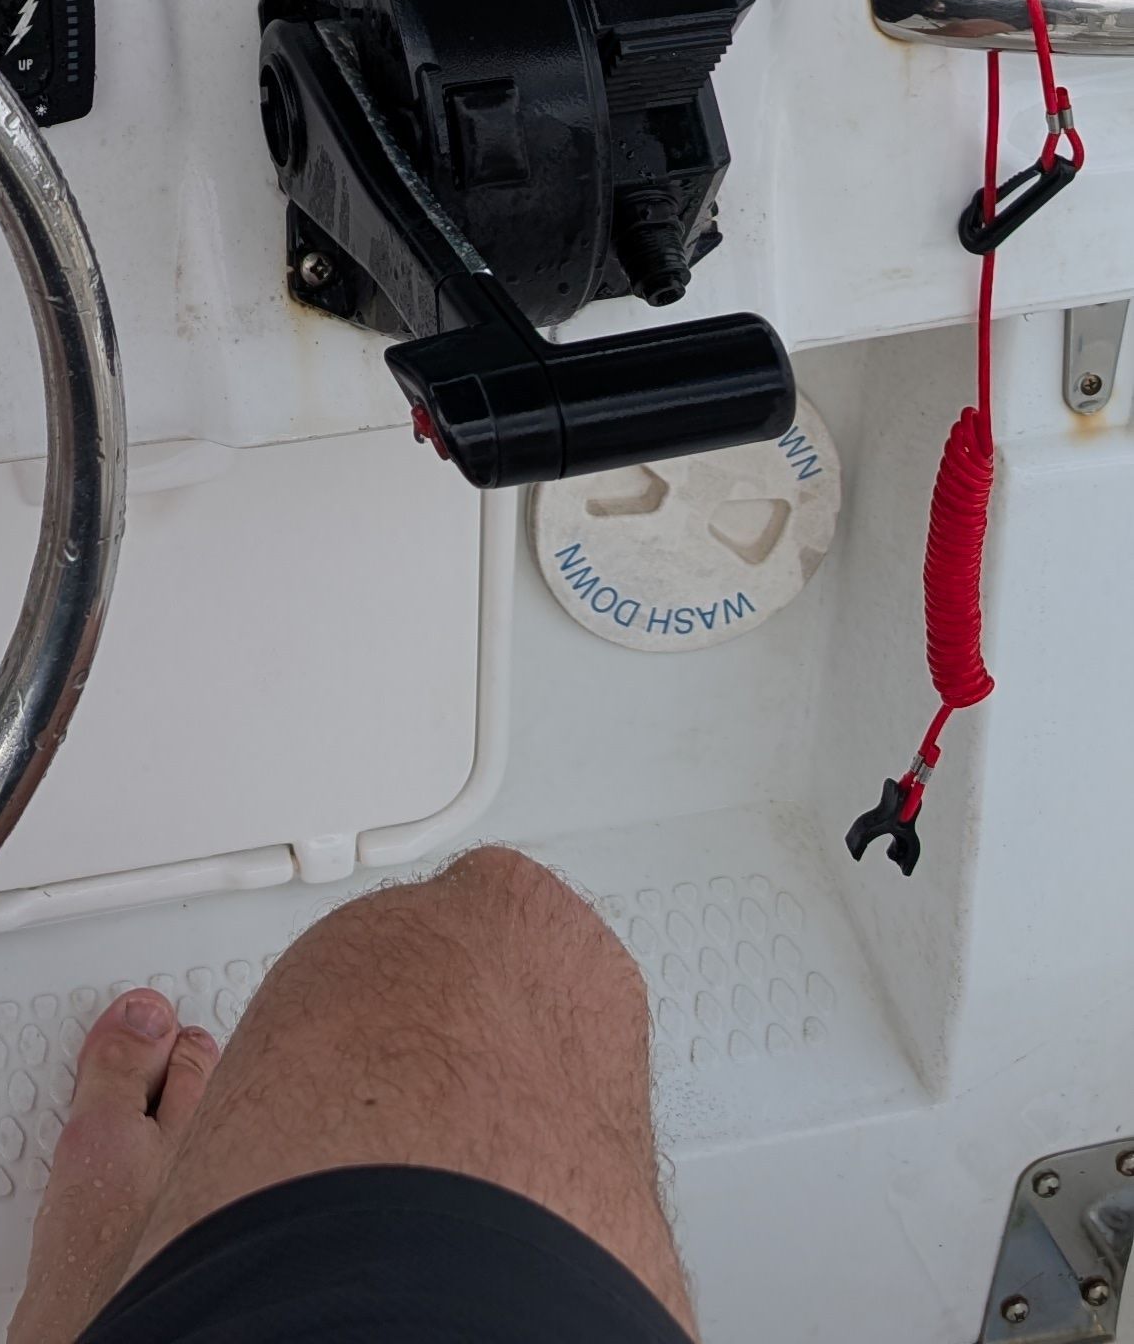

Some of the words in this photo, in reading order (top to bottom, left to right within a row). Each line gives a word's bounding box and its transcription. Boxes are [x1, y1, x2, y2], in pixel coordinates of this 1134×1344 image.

[18, 58, 34, 72] UP
[777, 425, 823, 482] WN
[554, 543, 642, 628] DOWN
[646, 592, 757, 635] WASH
